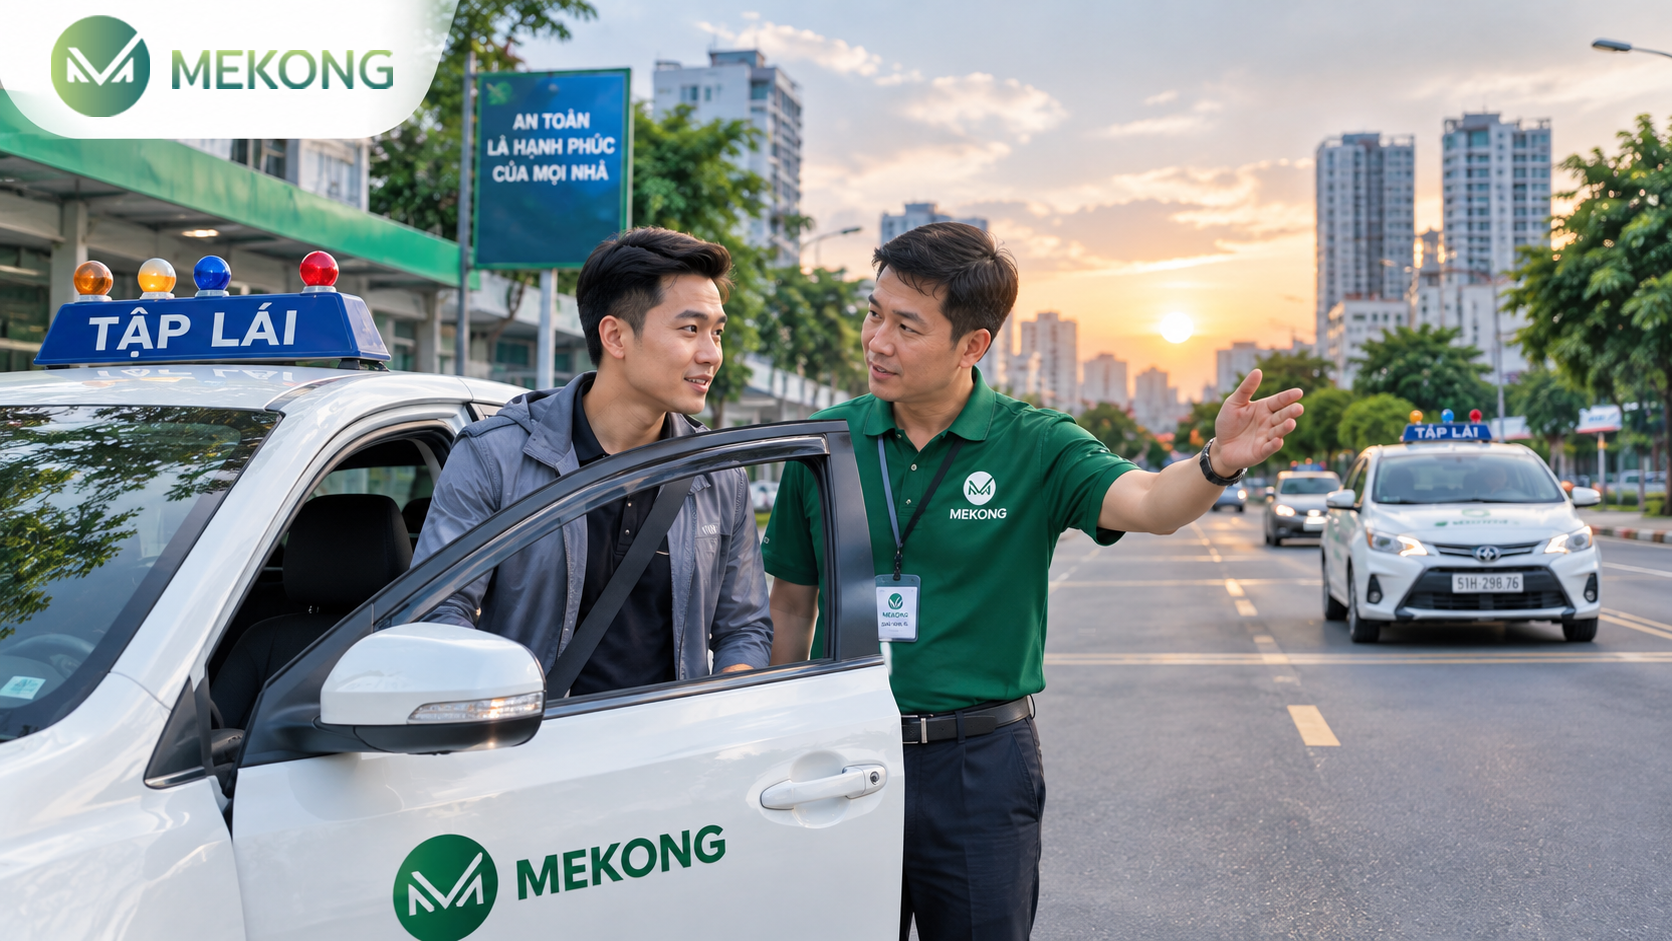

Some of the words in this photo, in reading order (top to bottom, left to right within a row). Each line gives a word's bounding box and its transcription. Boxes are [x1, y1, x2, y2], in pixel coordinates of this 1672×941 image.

[512, 113, 539, 130] AN
[513, 138, 563, 160] HẠNH
[492, 160, 529, 182] CỦA
[532, 164, 567, 186] MỌI
[88, 306, 192, 358] TẬP
[211, 302, 298, 348] LÁI
[949, 508, 1008, 520] MEKONG
[516, 824, 727, 901] MEKONG
